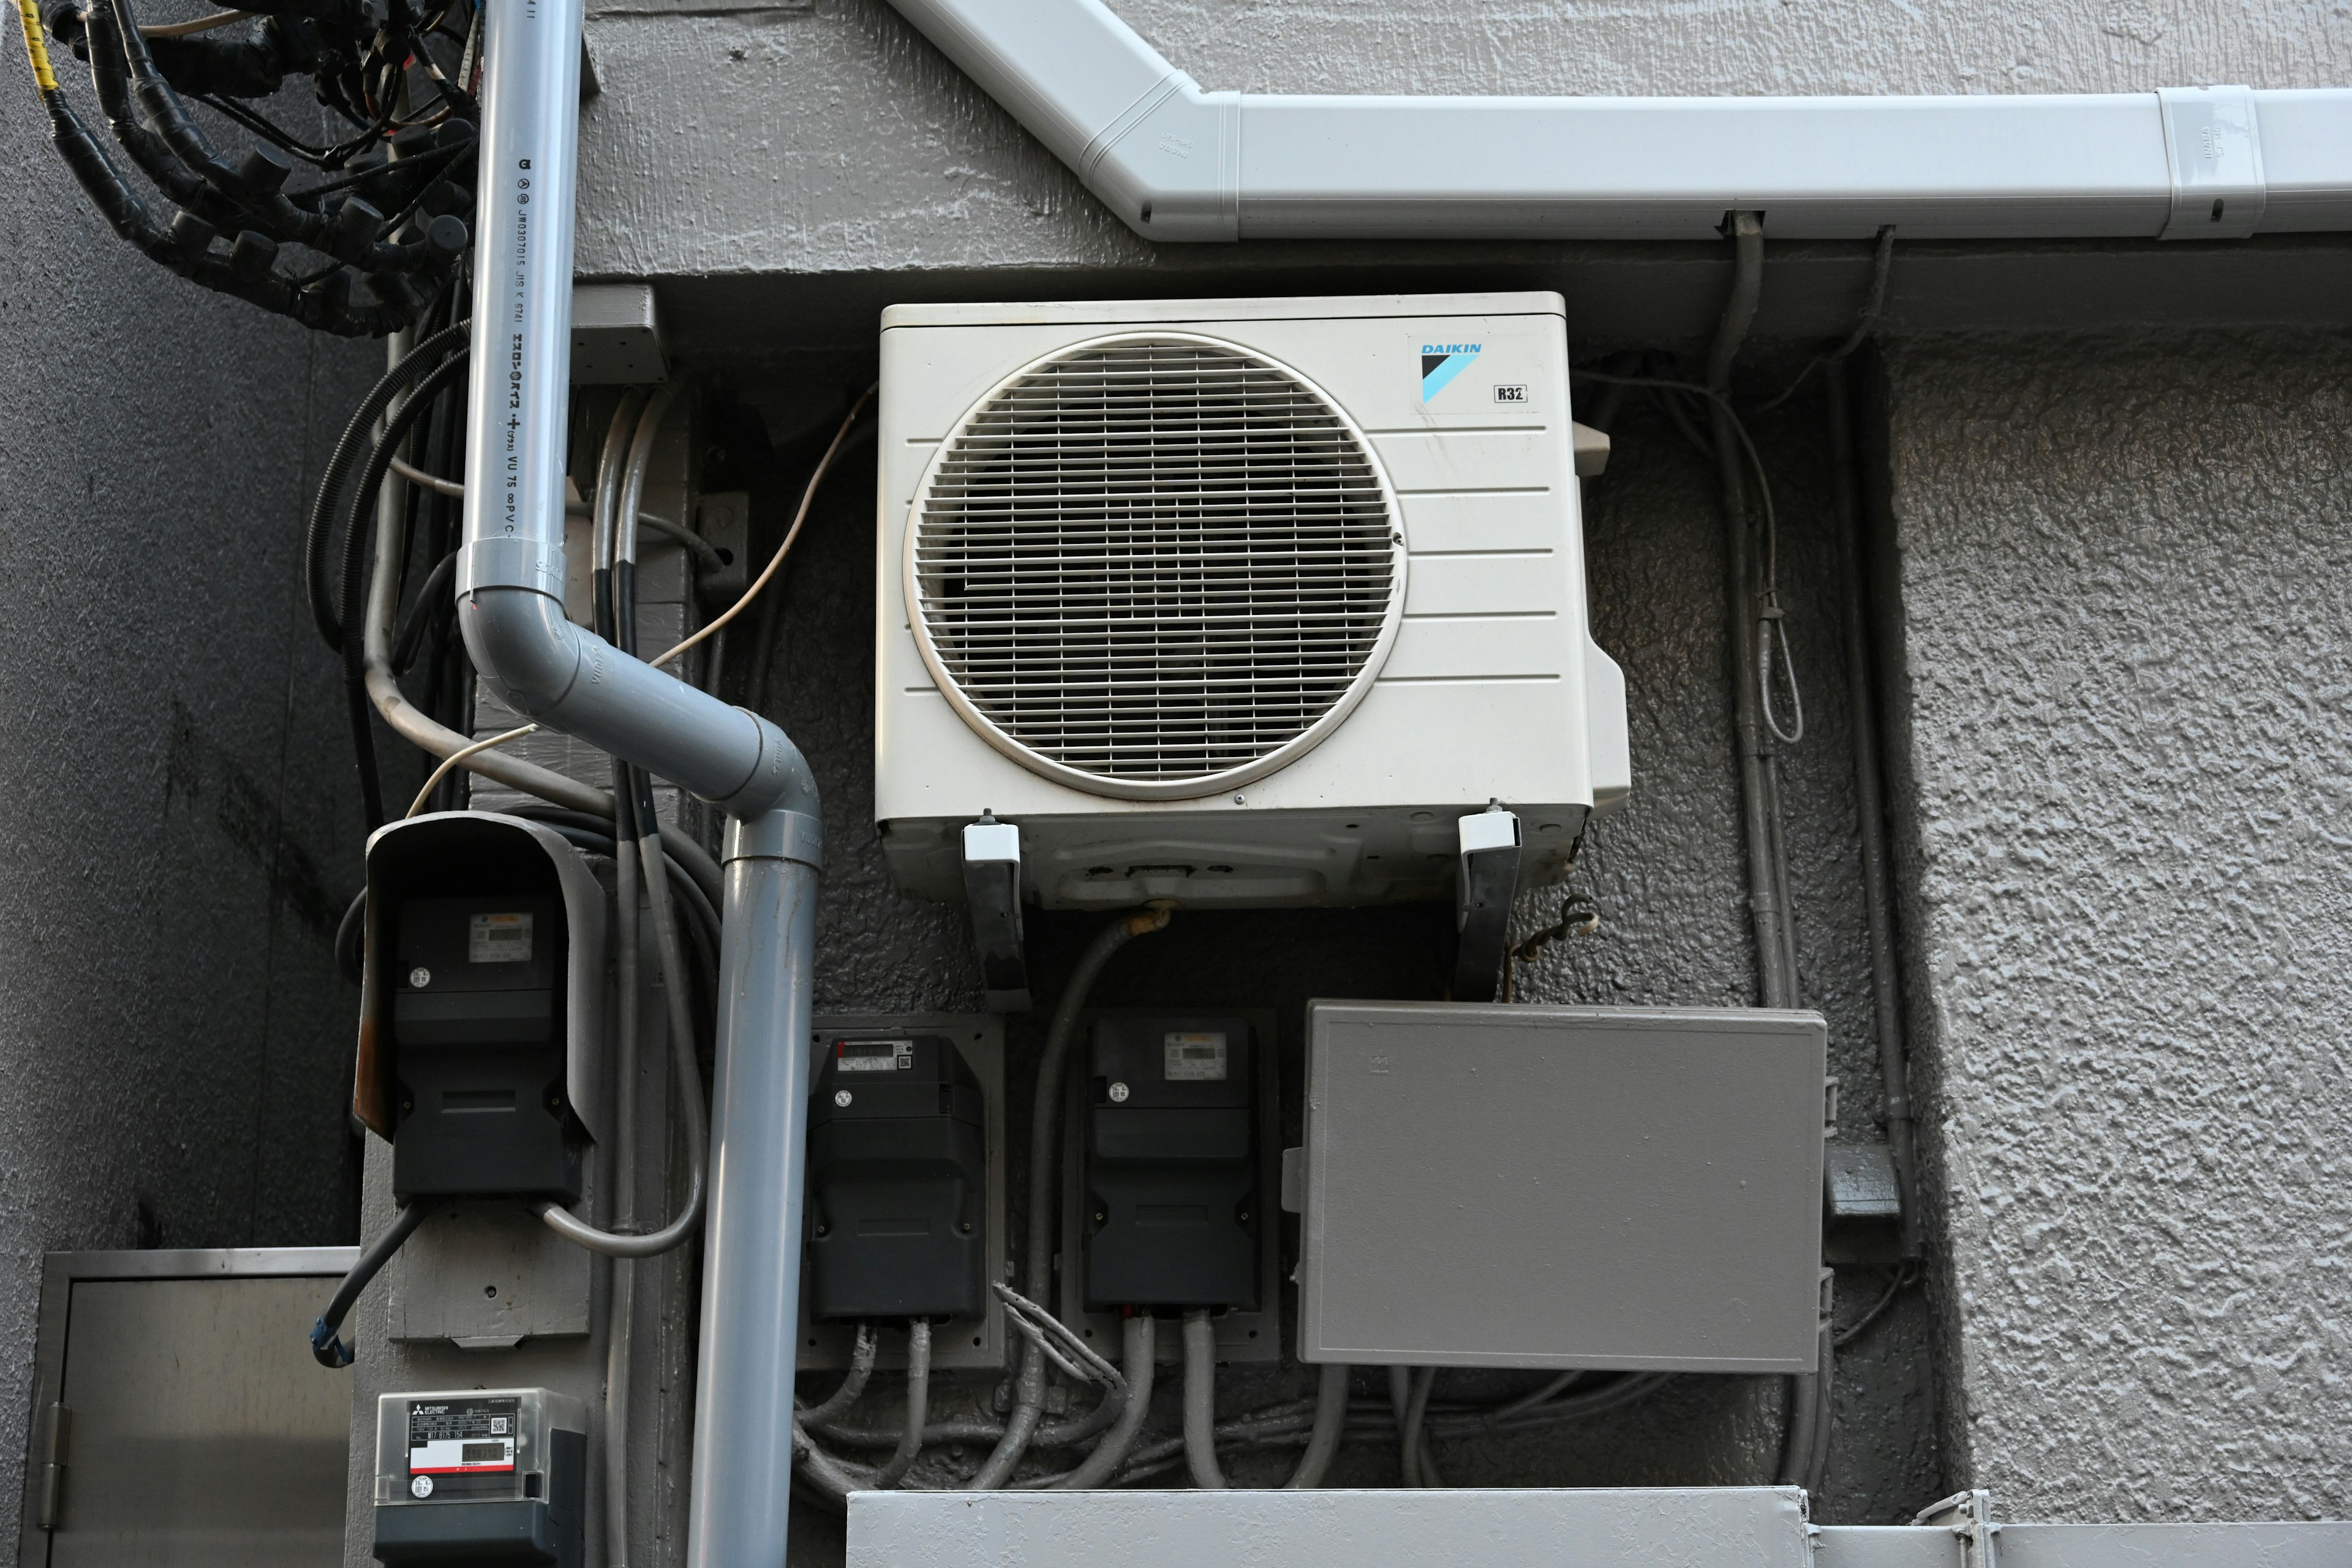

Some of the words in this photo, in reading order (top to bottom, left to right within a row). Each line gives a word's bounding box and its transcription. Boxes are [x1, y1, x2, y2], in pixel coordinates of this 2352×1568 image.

[1159, 141, 1188, 159] INABA
[2201, 127, 2212, 159] INABA
[2214, 127, 2224, 157] SJ-140
[517, 210, 527, 265] JW0307015
[516, 271, 524, 287] JIS
[514, 303, 523, 322] 6741
[1422, 344, 1482, 353] DAIKIN
[1498, 388, 1523, 400] R32
[508, 457, 517, 470] VU
[507, 476, 516, 488] 75
